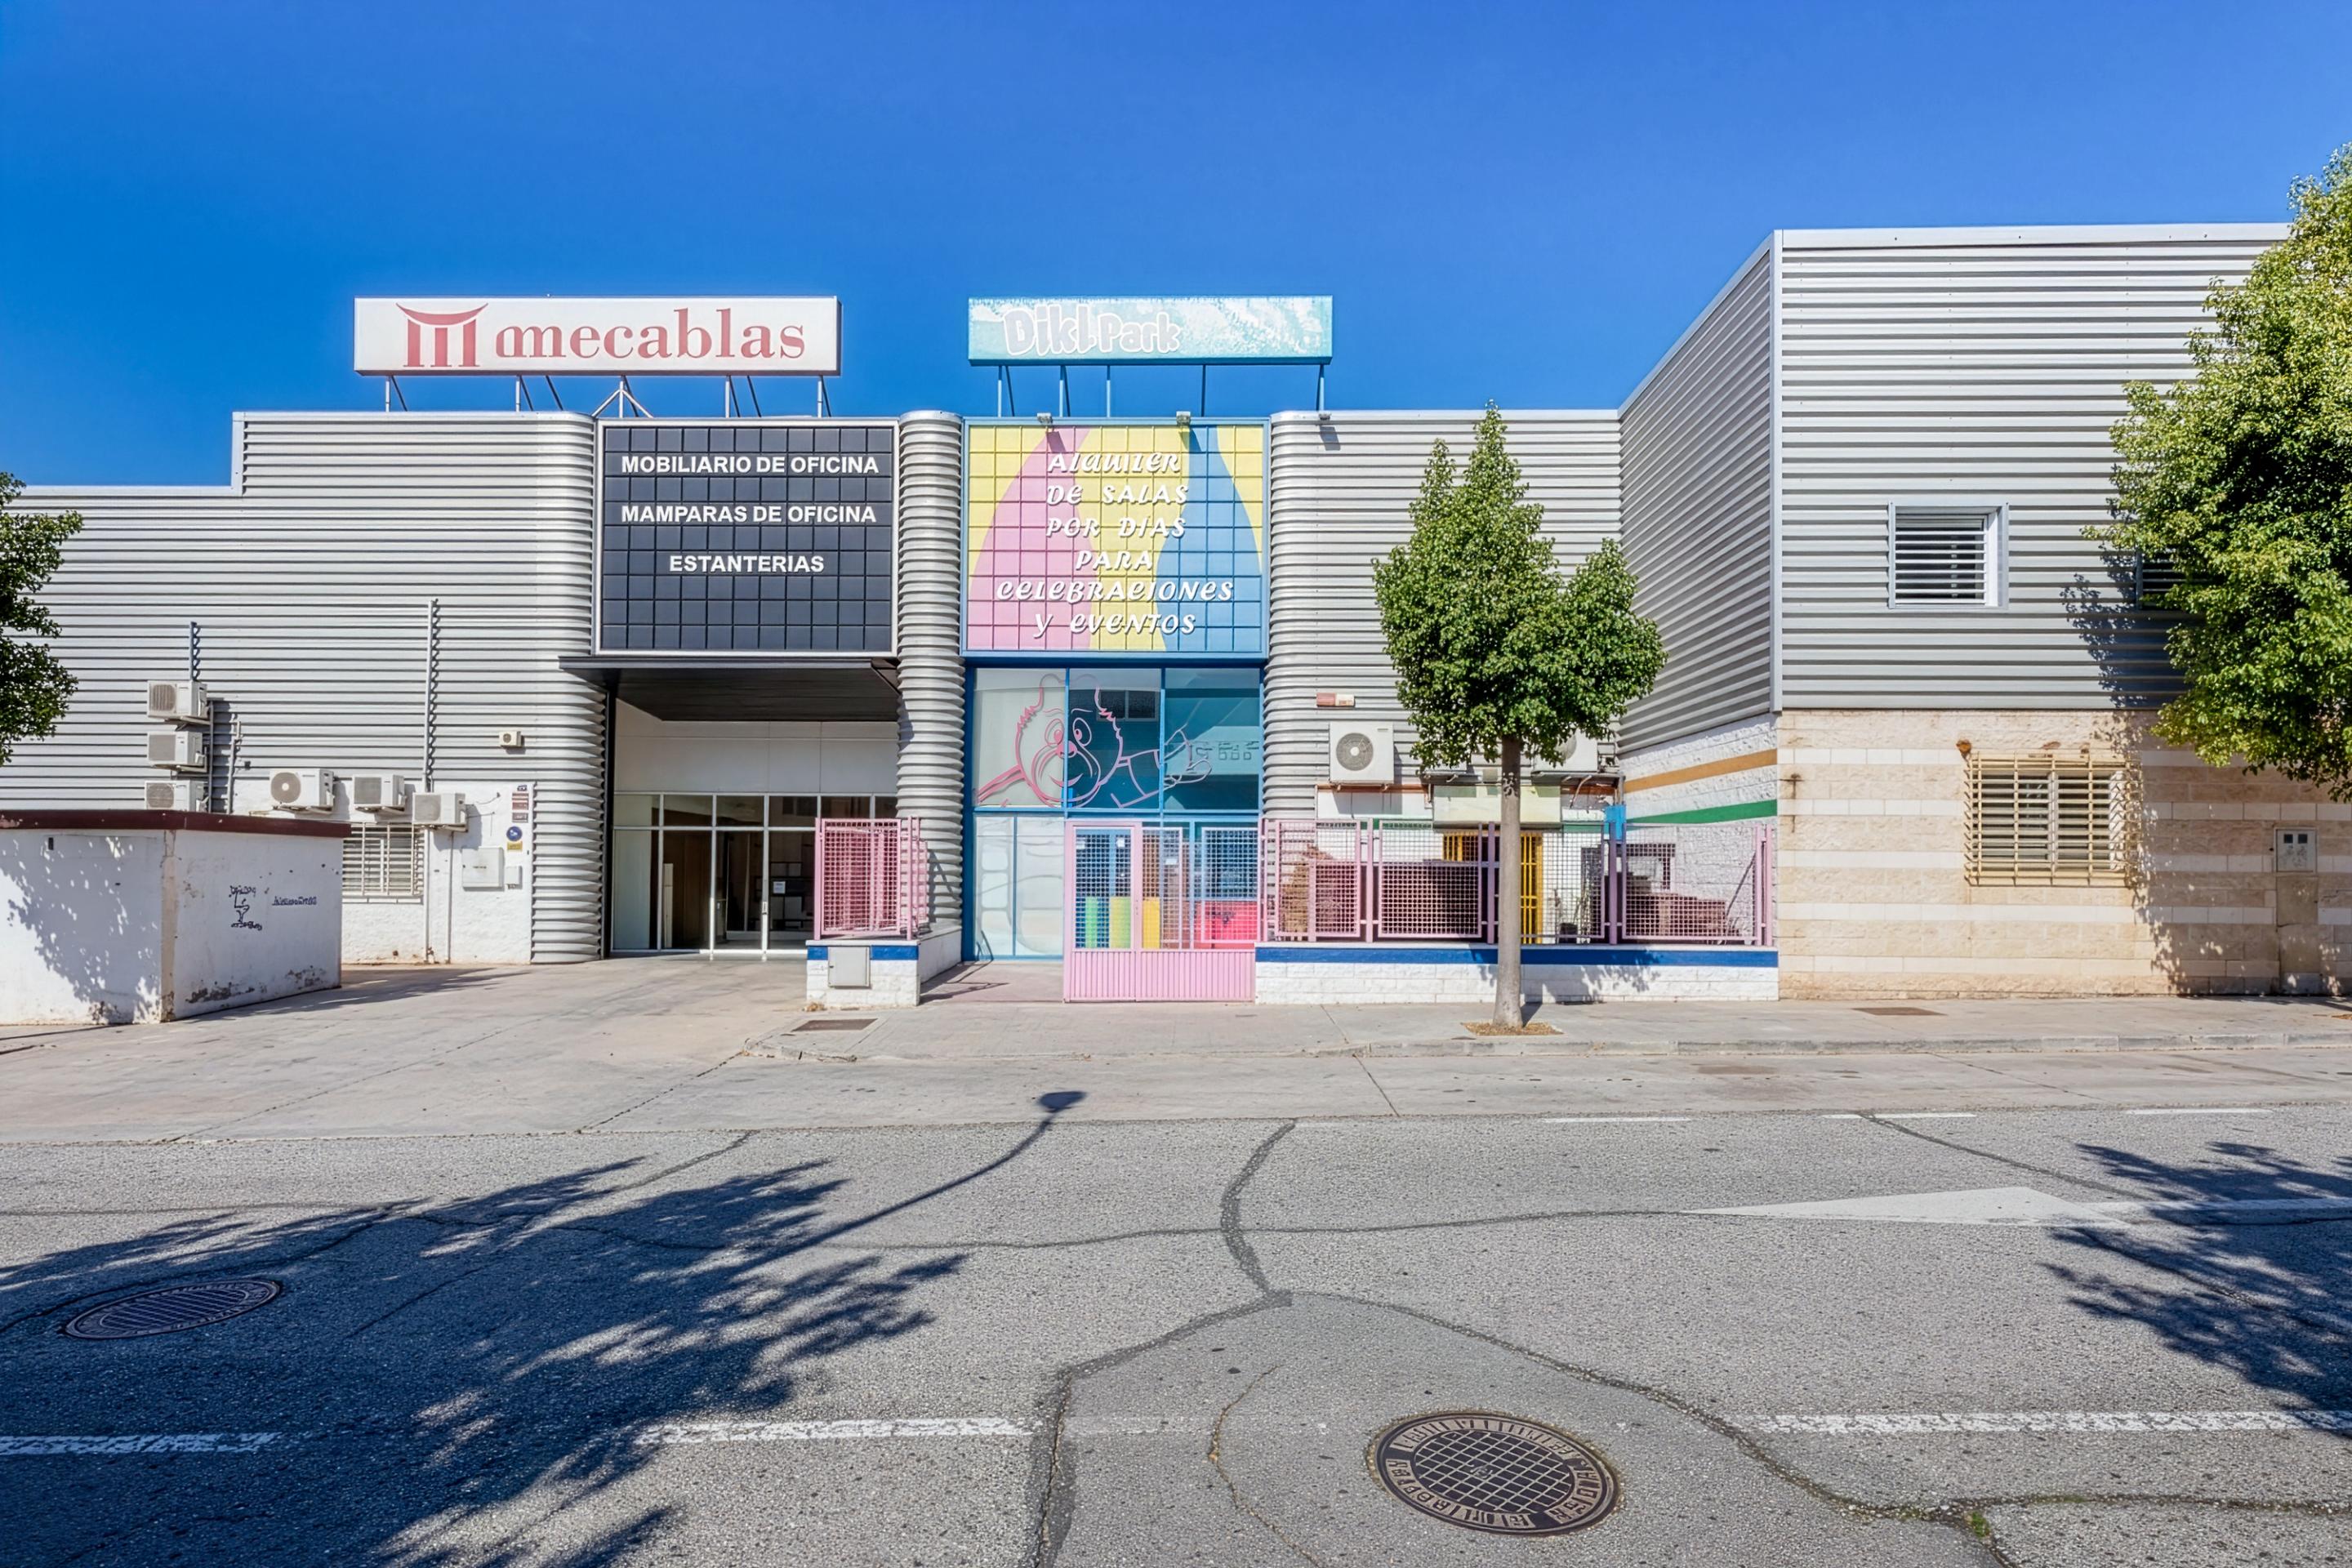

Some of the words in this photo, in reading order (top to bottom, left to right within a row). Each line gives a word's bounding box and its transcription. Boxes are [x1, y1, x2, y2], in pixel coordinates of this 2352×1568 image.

[495, 308, 805, 359] mecablas
[1098, 312, 1180, 354] Park
[621, 457, 751, 474] MOBILIARIO
[756, 457, 785, 474] DE
[791, 457, 880, 474] OFICINA
[1047, 485, 1083, 506] DE
[1102, 485, 1188, 505] SALAS
[621, 506, 747, 523] MAMPARAS
[753, 506, 782, 522] DE
[788, 506, 876, 523] OFICINA
[1046, 518, 1101, 537] POR
[670, 555, 824, 572] ESTANTERIAS
[1076, 550, 1152, 570] PARA
